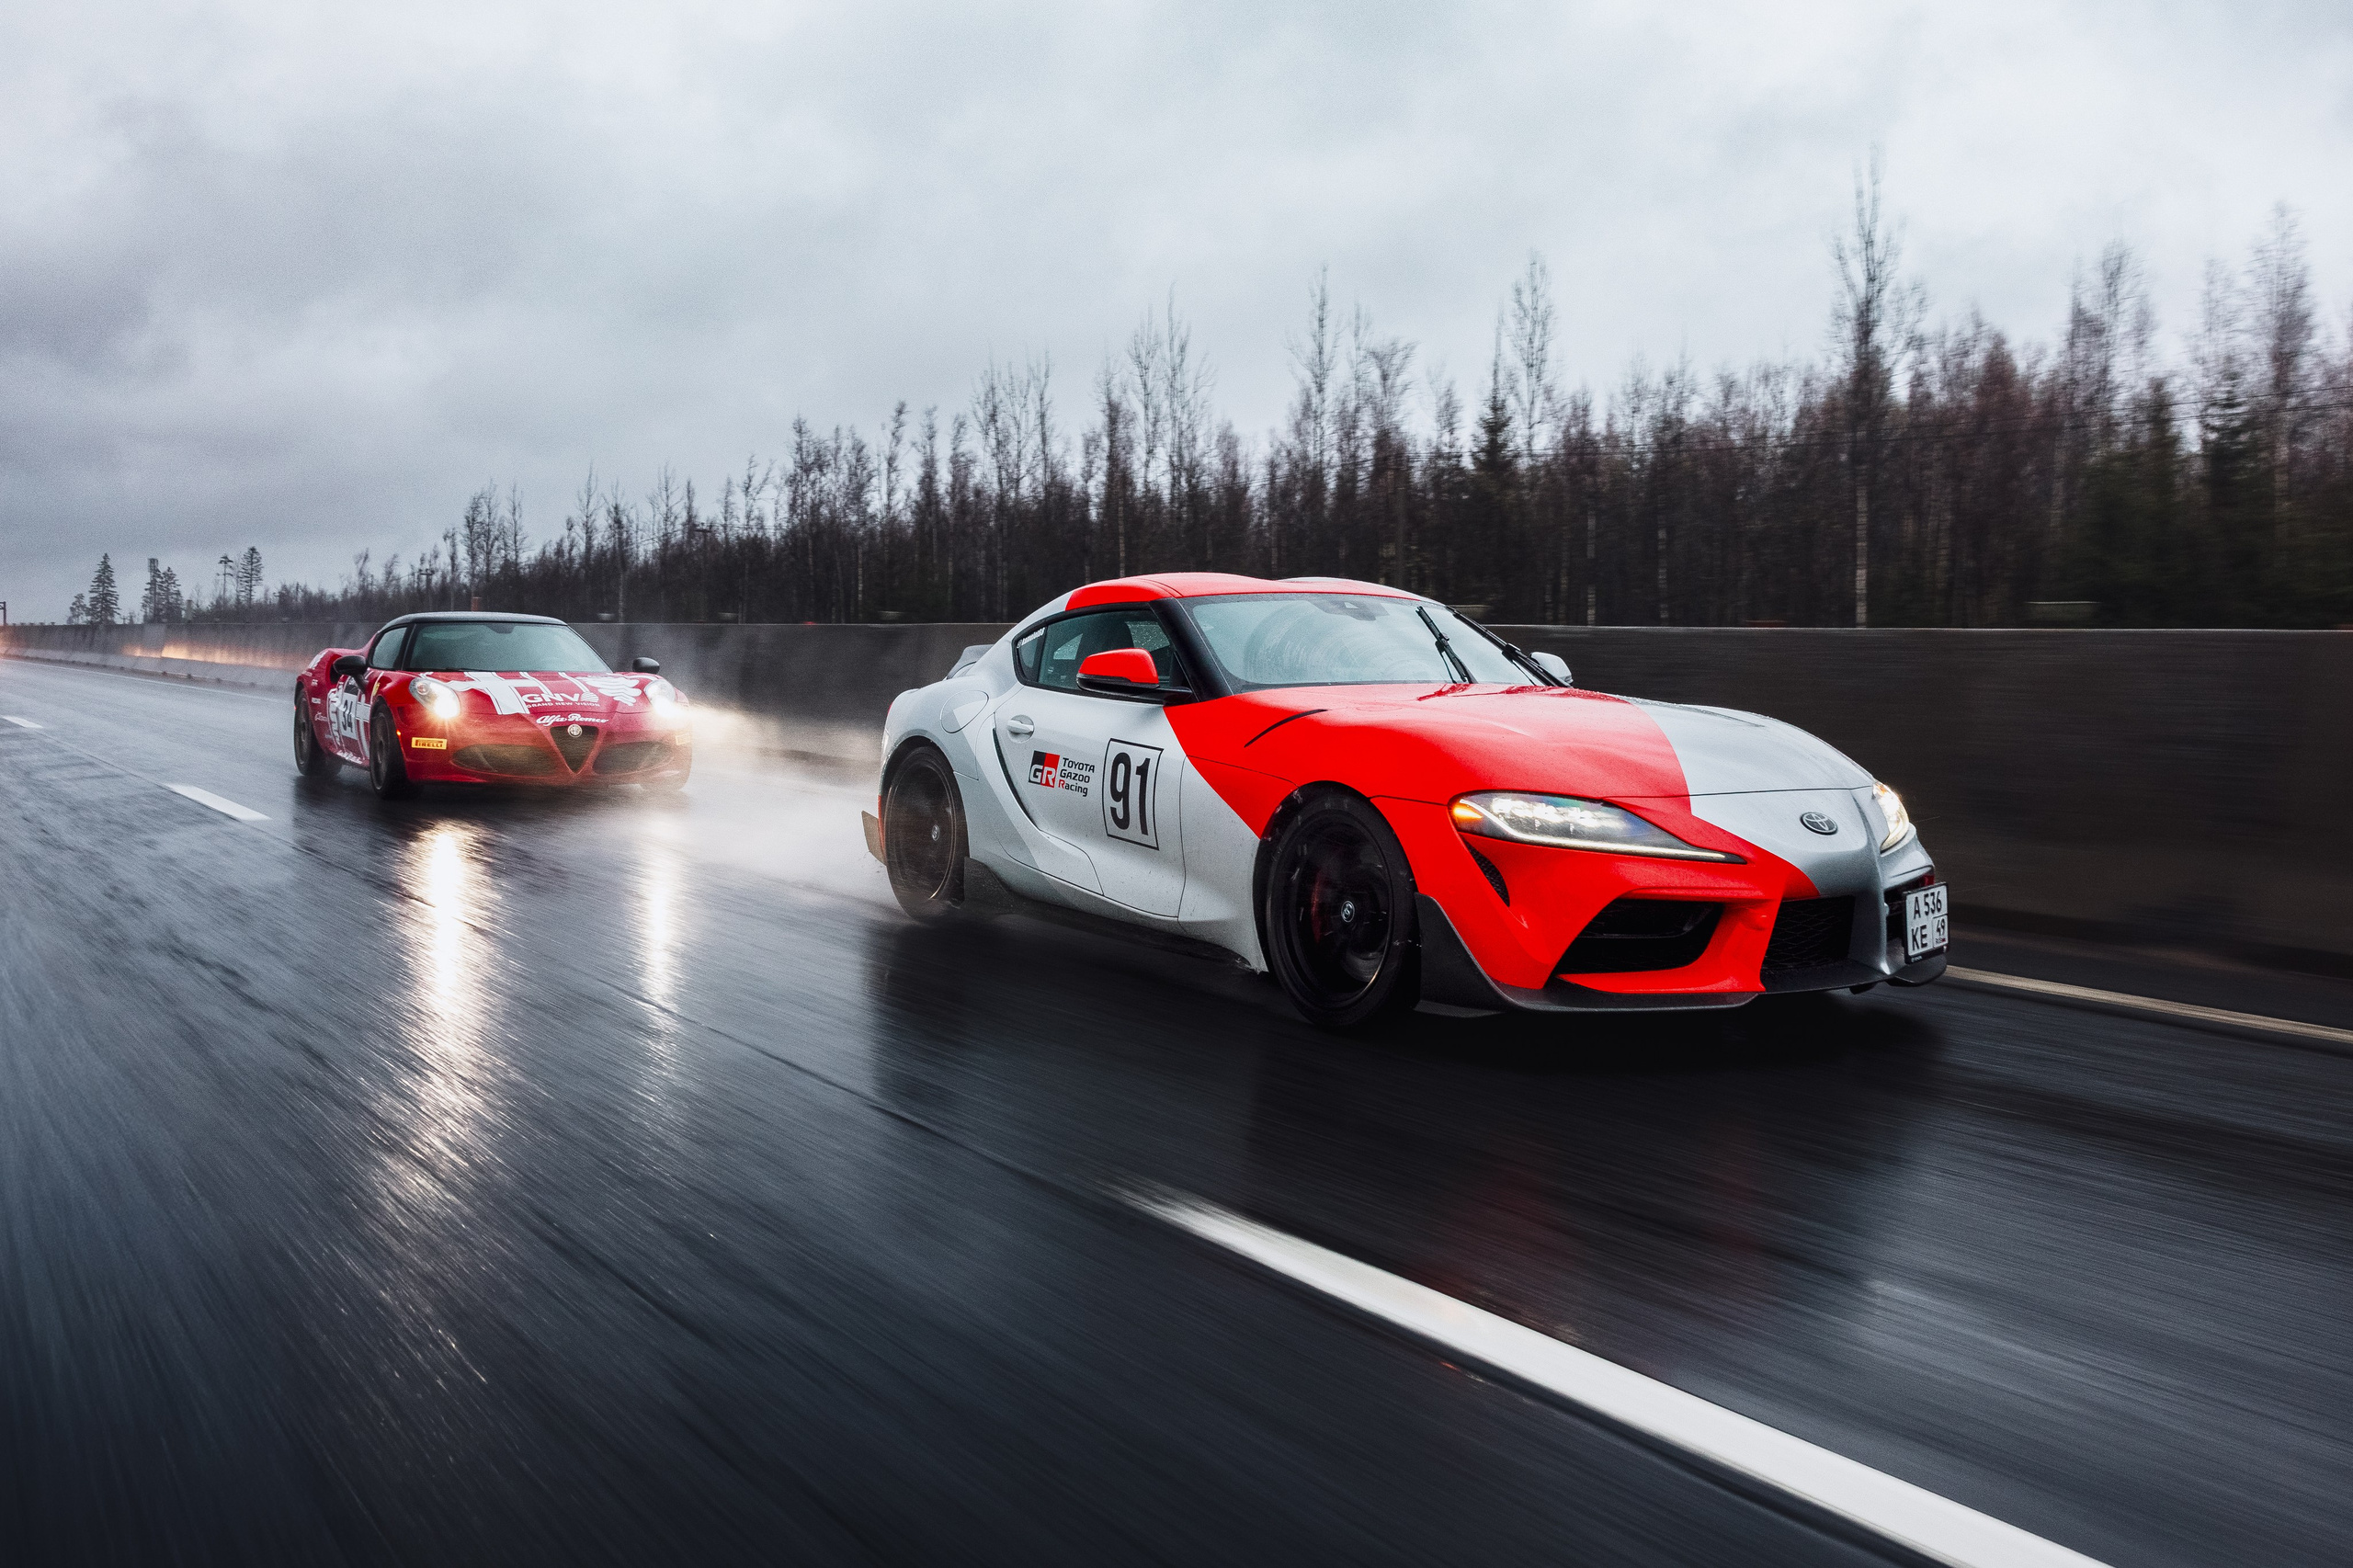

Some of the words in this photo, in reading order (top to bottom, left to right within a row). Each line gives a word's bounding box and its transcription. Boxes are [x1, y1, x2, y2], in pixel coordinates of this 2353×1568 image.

[521, 693, 580, 703] GNV
[342, 699, 353, 733] 34
[536, 714, 567, 726] Alfa
[568, 713, 608, 723] Romeo
[415, 739, 443, 747] PIRELLI
[1063, 757, 1095, 773] TOYOTA
[1029, 764, 1056, 787] GR
[1060, 769, 1090, 783] GAZOO
[1058, 779, 1088, 797] Racing
[1110, 752, 1151, 836] 91
[1911, 925, 1928, 951] KE
